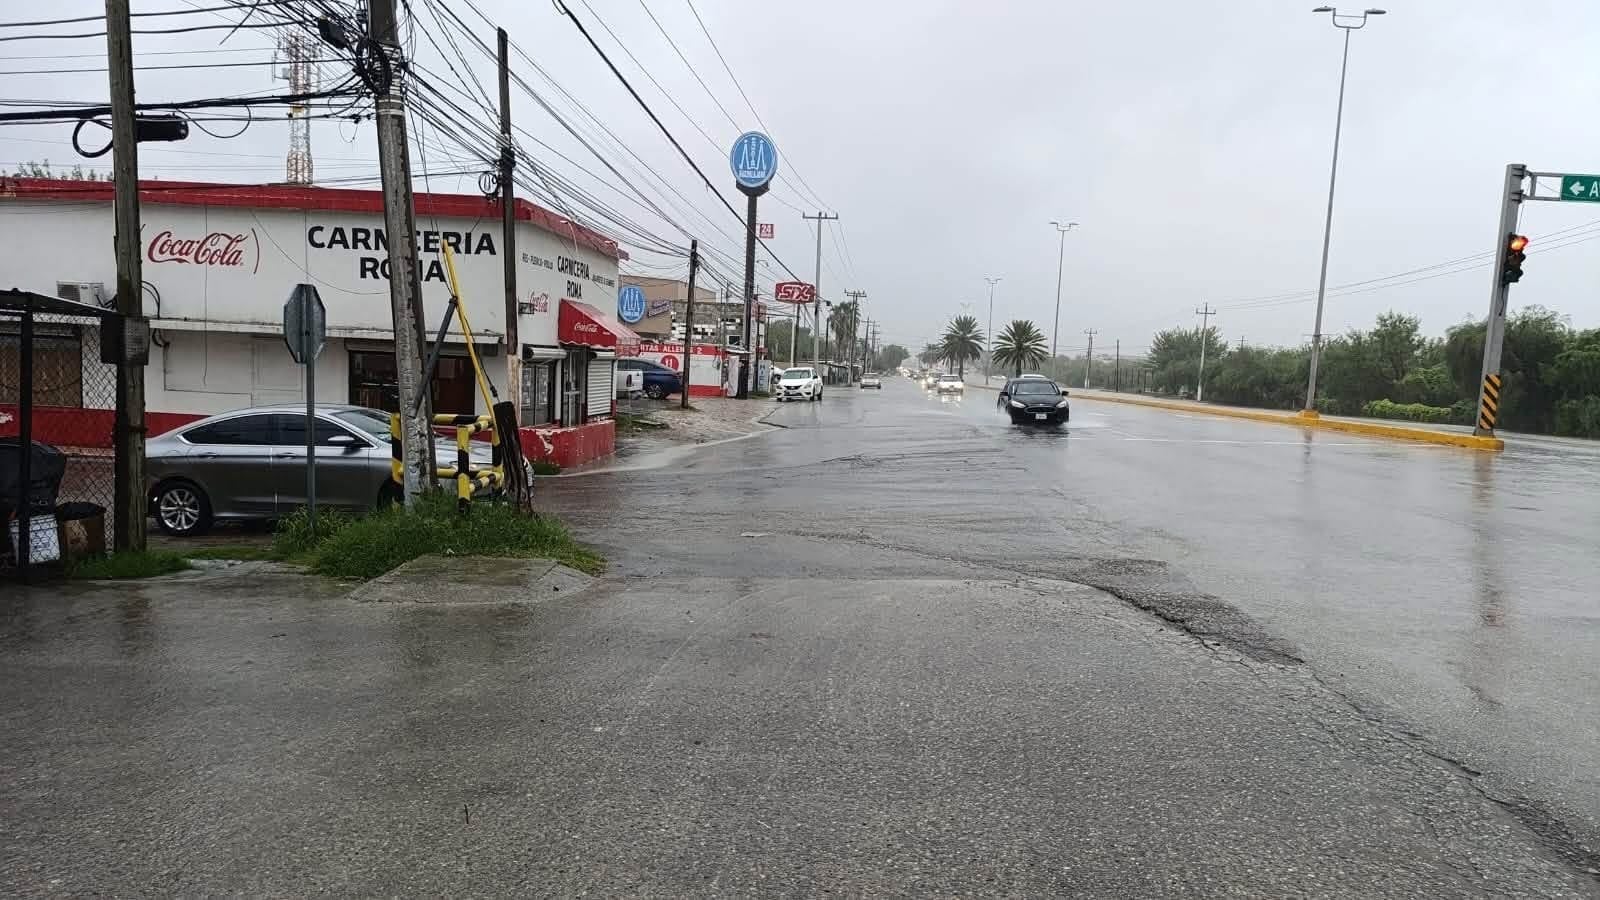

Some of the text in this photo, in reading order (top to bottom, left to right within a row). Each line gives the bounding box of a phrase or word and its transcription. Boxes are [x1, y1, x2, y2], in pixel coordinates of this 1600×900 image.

[1589, 181, 1600, 197] A
[761, 224, 772, 233] 24
[308, 226, 496, 255] CARNERIA
[360, 257, 446, 282] RA
[557, 256, 590, 281] CARNICERIA
[566, 280, 583, 299] ROMA
[778, 284, 811, 301] SIX
[662, 345, 694, 354] ALLEN
[697, 346, 703, 355] 2
